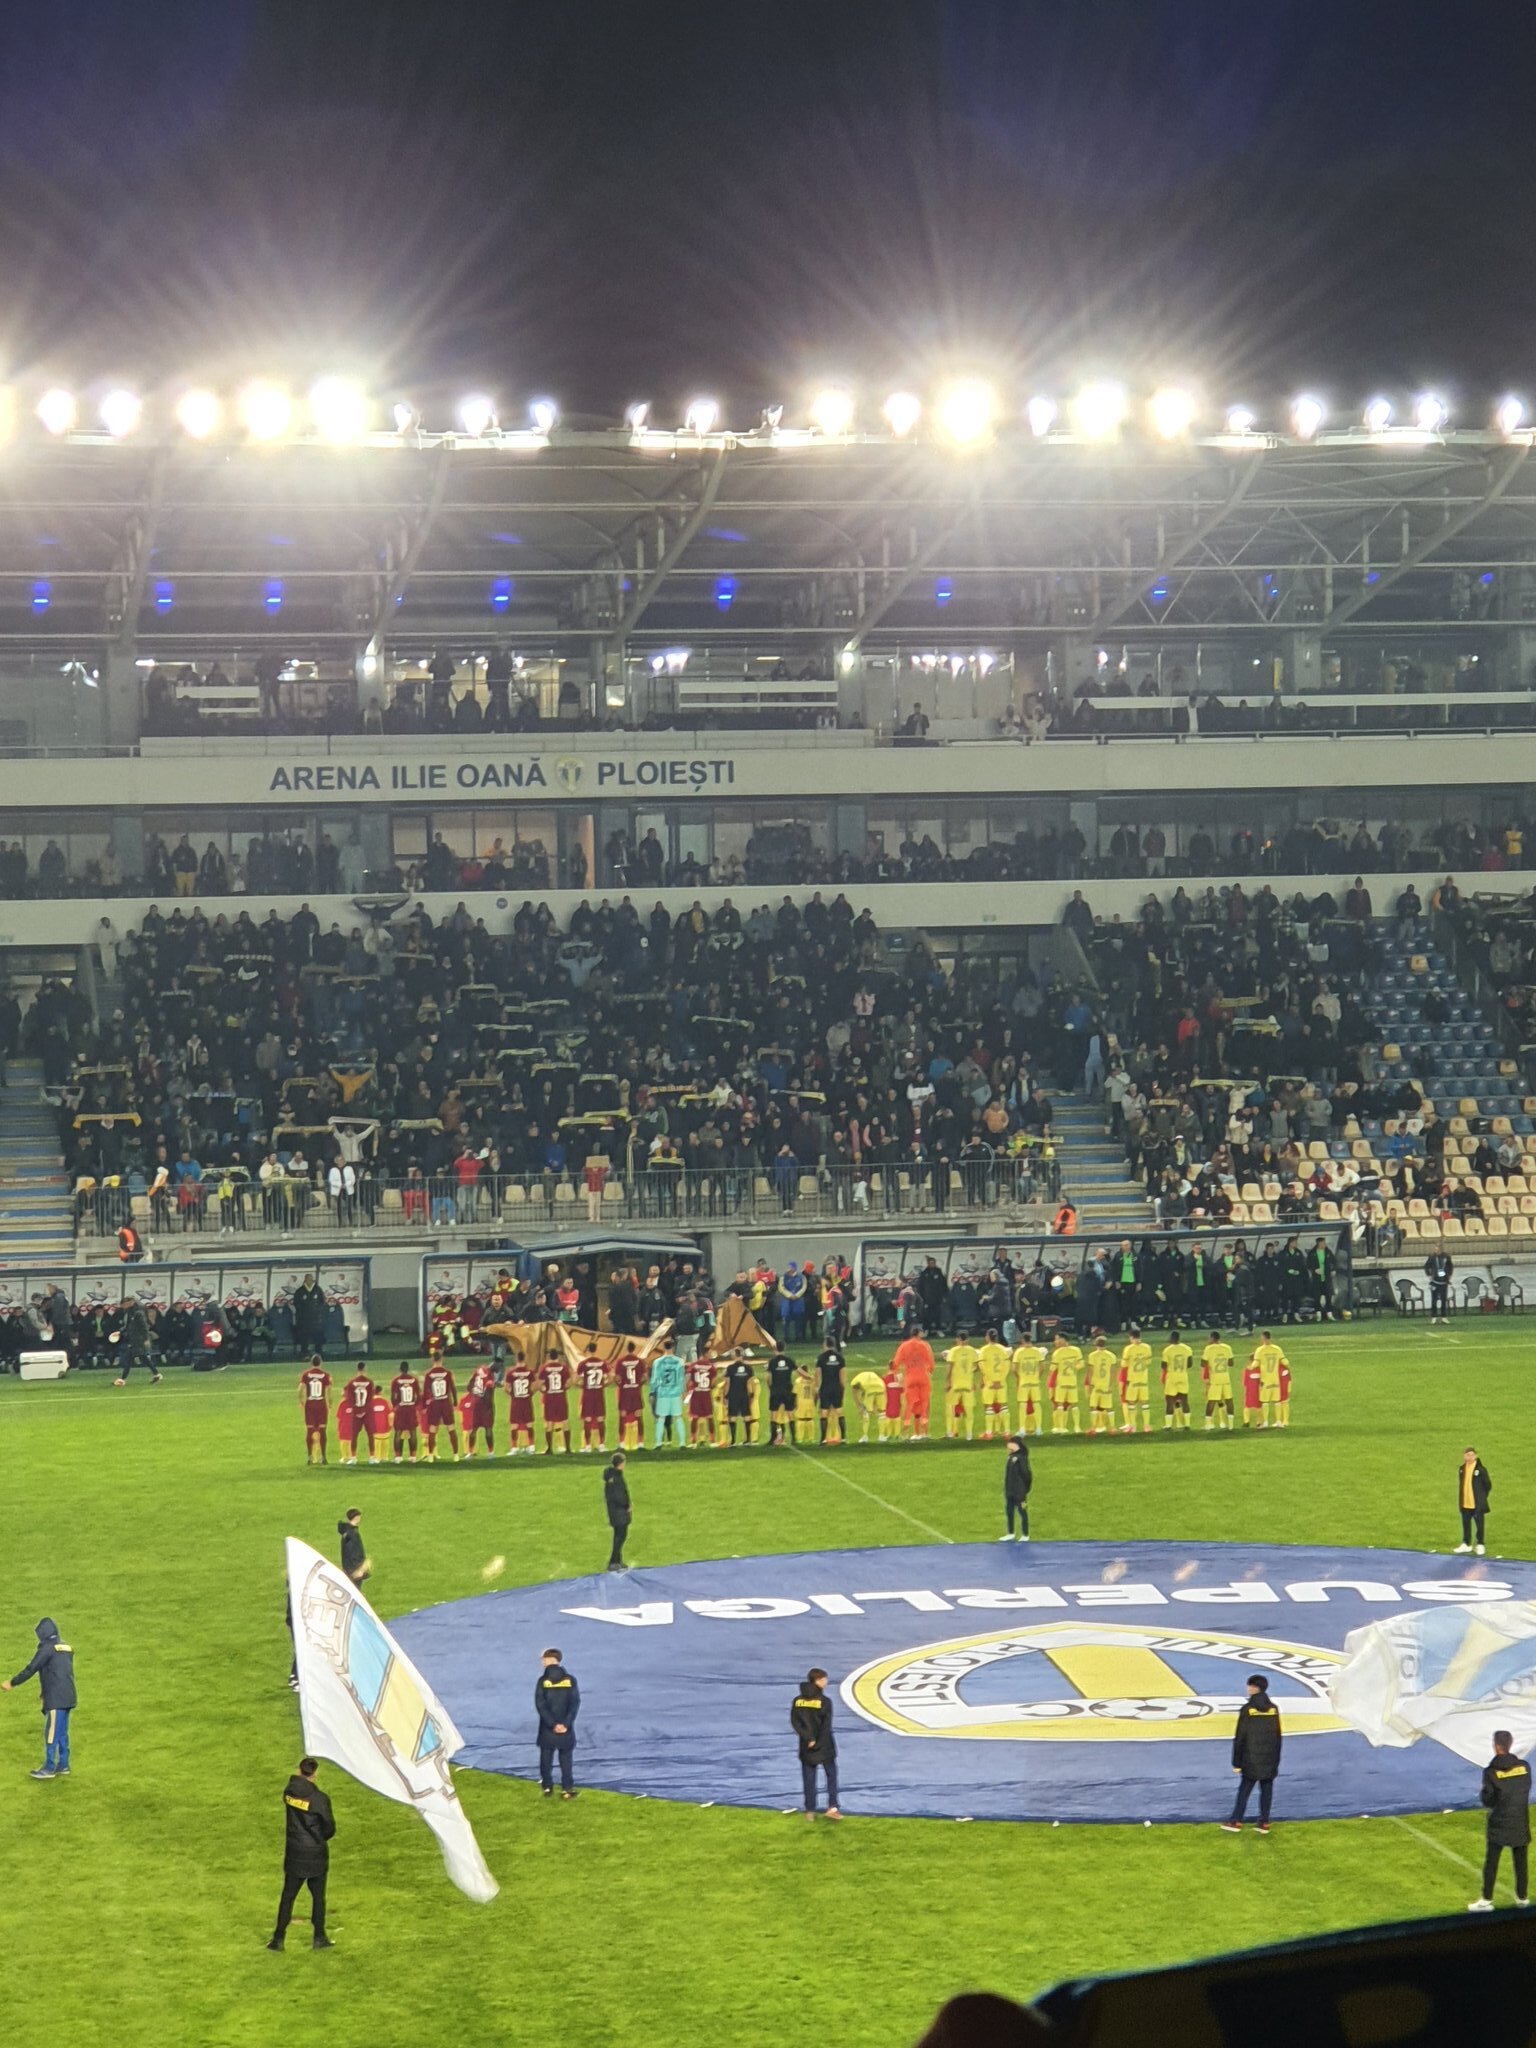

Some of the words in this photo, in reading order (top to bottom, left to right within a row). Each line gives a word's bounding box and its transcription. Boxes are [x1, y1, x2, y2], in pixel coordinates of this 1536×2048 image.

[270, 766, 380, 790] ARENA
[392, 764, 447, 789] ILIE
[456, 757, 547, 789] OANĂ
[597, 760, 735, 792] PLOIEȘTI
[309, 1380, 322, 1397] 10
[587, 1369, 603, 1386] 27
[626, 1369, 636, 1385] 4
[561, 1580, 1515, 1627] SUPERLIGA
[889, 1643, 1039, 1707] PLOIESTI
[1144, 1636, 1332, 1692] TROLUL
